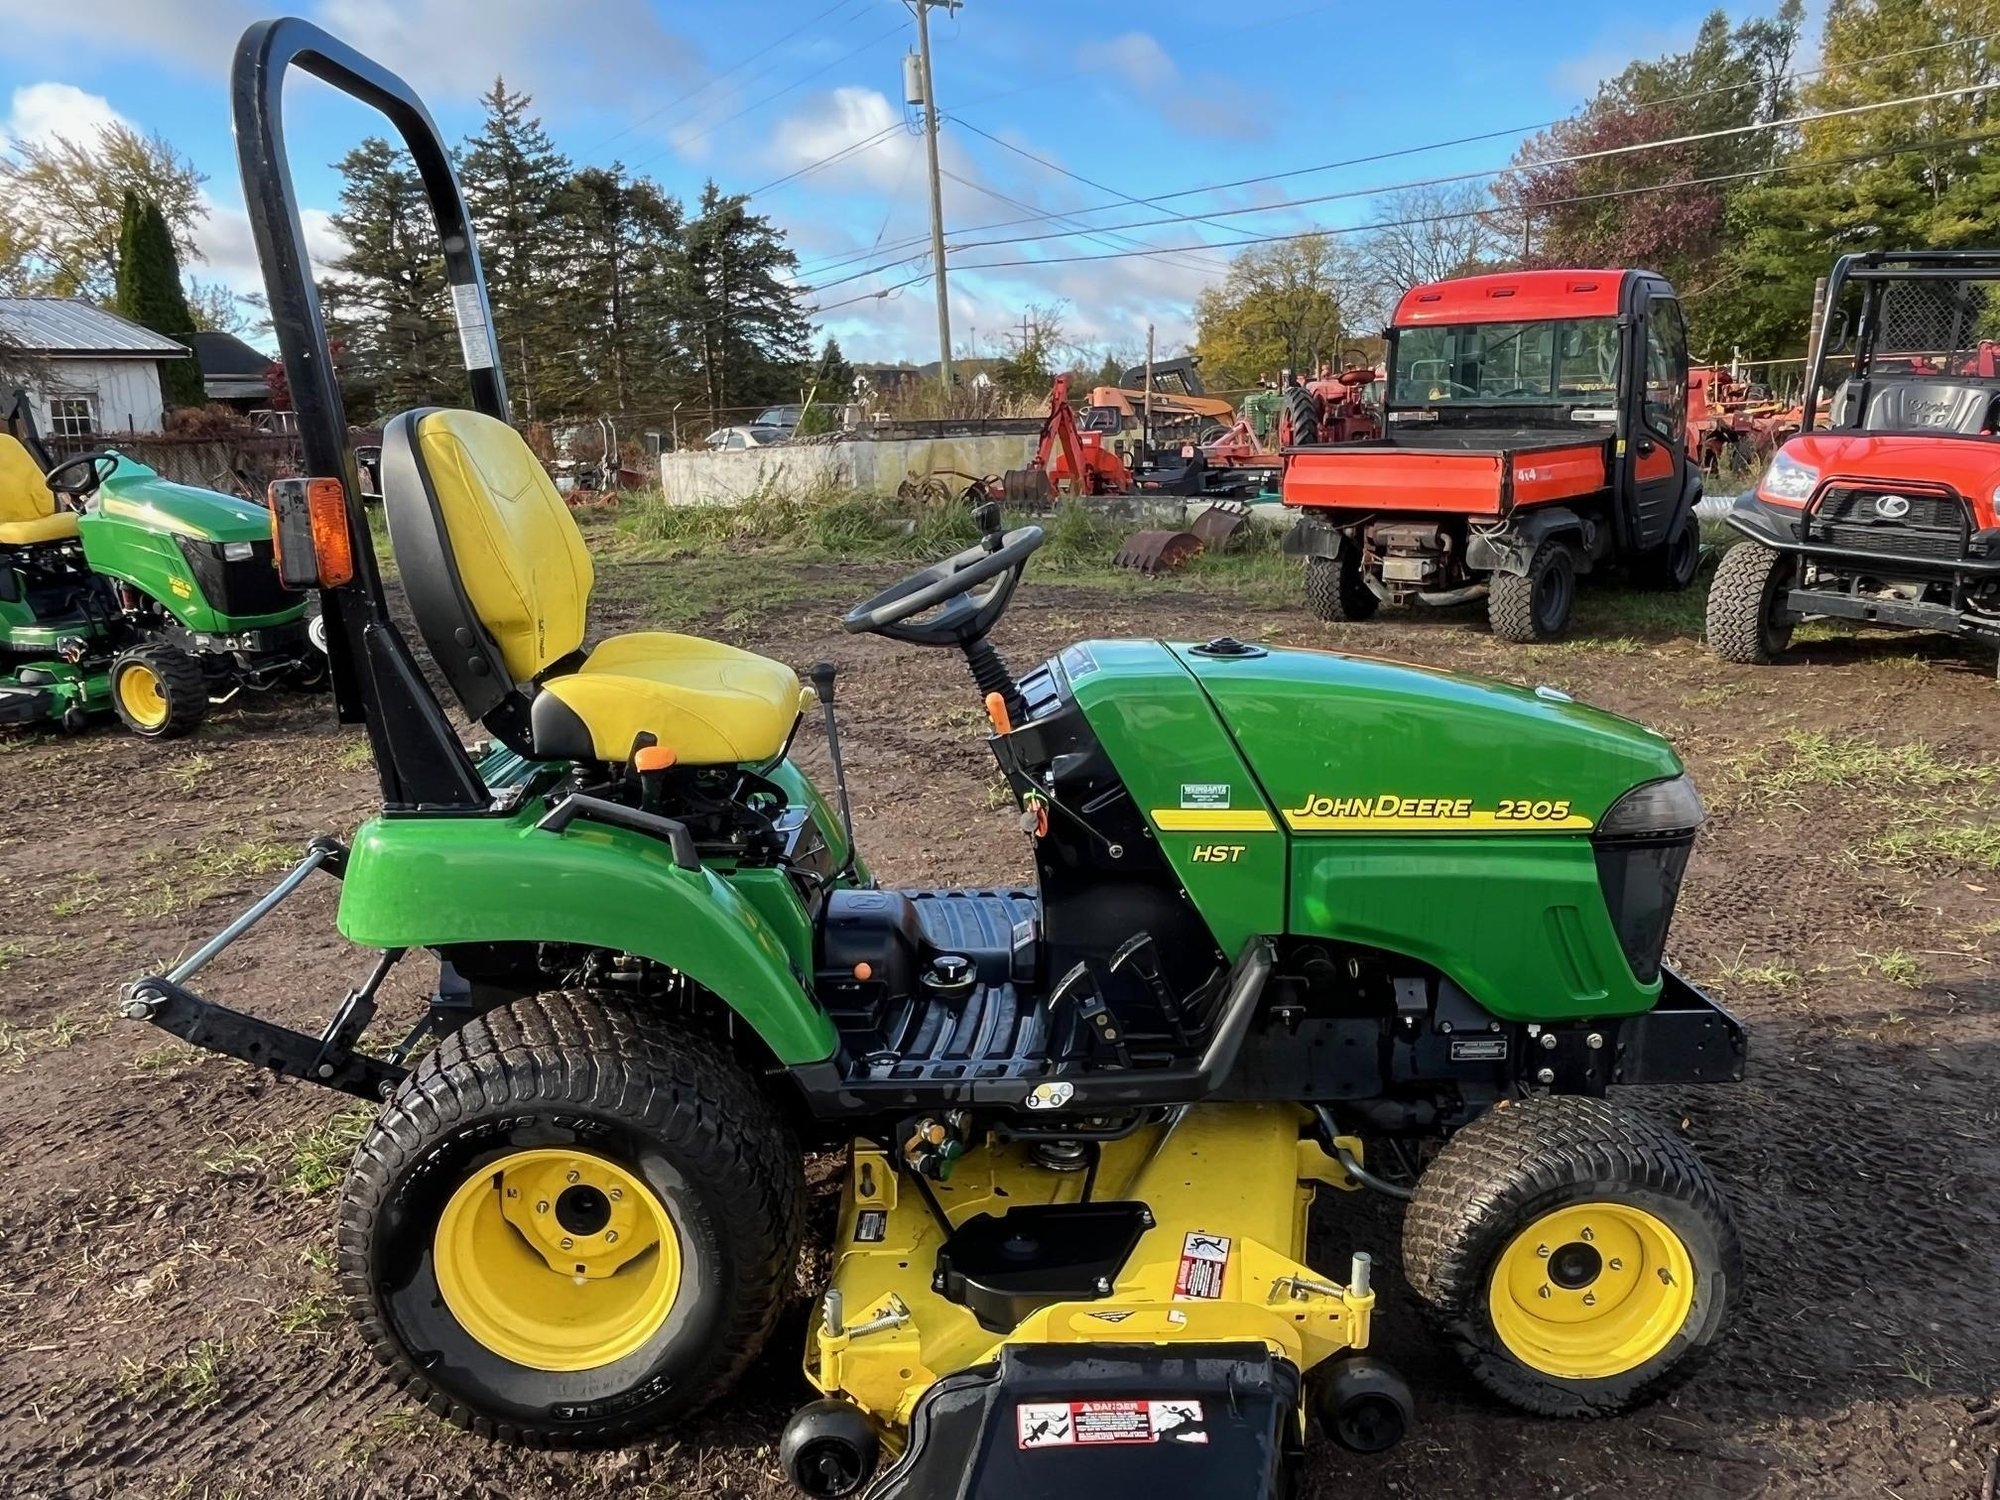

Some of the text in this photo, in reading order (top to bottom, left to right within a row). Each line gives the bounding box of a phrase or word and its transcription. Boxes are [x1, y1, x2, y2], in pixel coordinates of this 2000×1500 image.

[1292, 794, 1571, 820] JOHN DEERE 2305
[1191, 845, 1247, 863] HST
